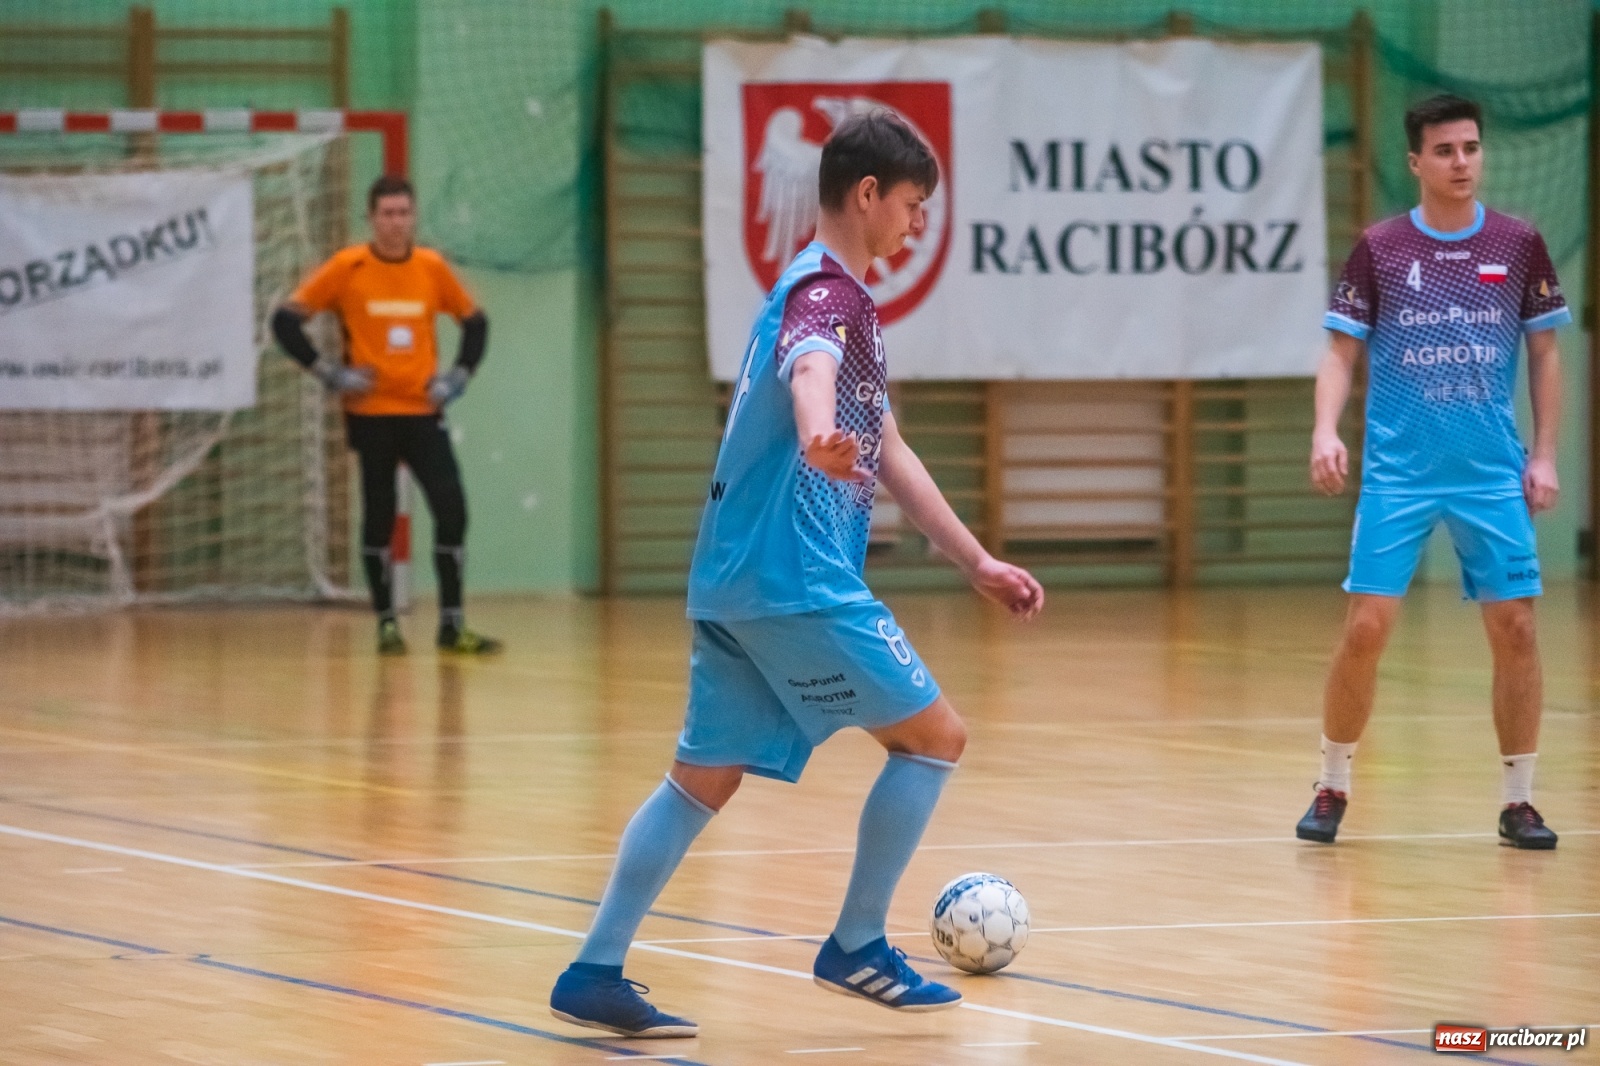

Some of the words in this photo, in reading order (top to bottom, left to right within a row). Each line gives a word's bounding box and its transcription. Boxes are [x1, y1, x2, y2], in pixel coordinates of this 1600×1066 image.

[1009, 138, 1261, 193] MIASTO
[969, 206, 1303, 275] RACIBÓRZ
[1406, 260, 1421, 291] 4
[876, 618, 912, 666] 6
